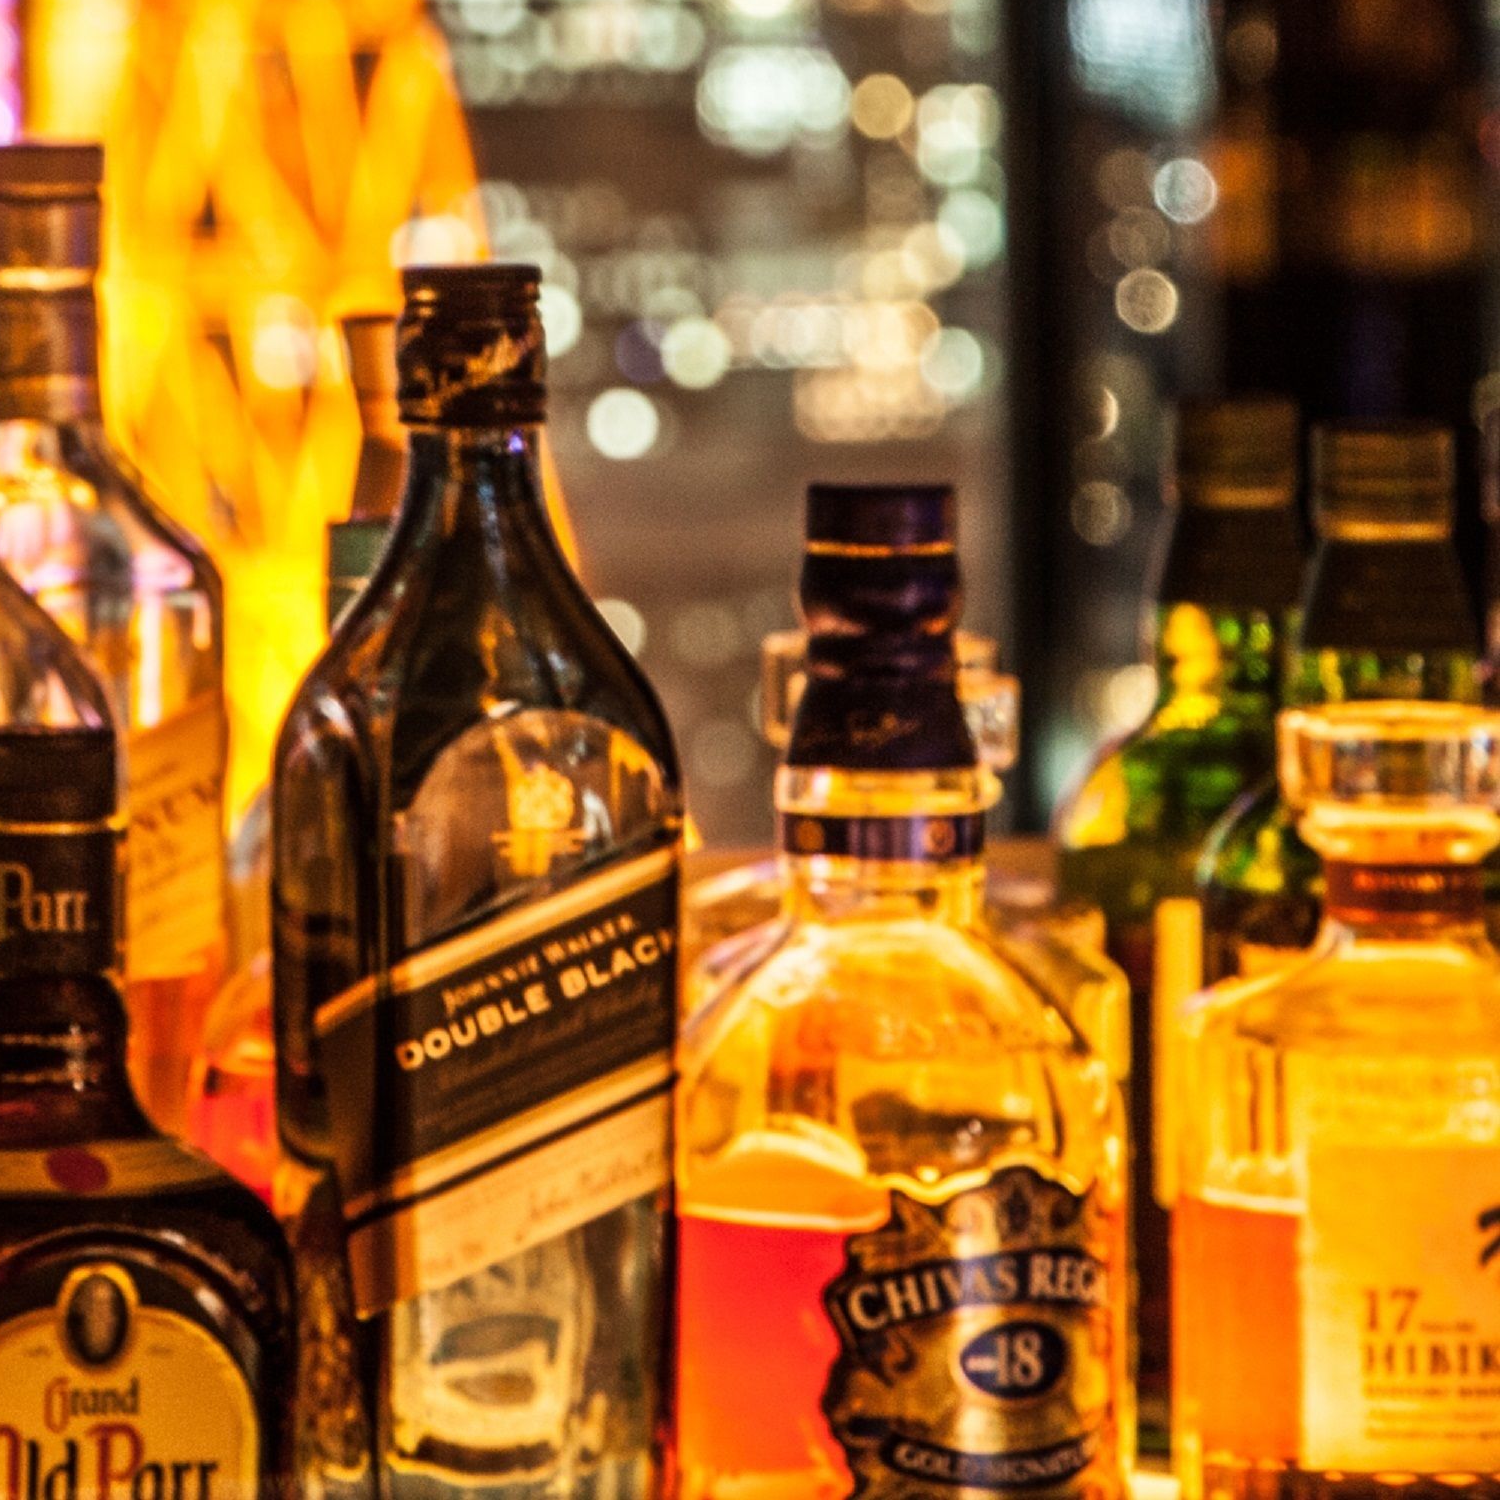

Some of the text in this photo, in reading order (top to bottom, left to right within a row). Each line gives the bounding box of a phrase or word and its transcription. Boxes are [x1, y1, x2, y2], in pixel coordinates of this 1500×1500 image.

[395, 982, 552, 1071] DOUBLE
[847, 1258, 1019, 1332] CHIVAS
[1365, 1288, 1420, 1334] 17
[993, 1329, 1045, 1389] 18
[43, 1375, 141, 1434] Grand
[84, 1421, 219, 1500] Parr
